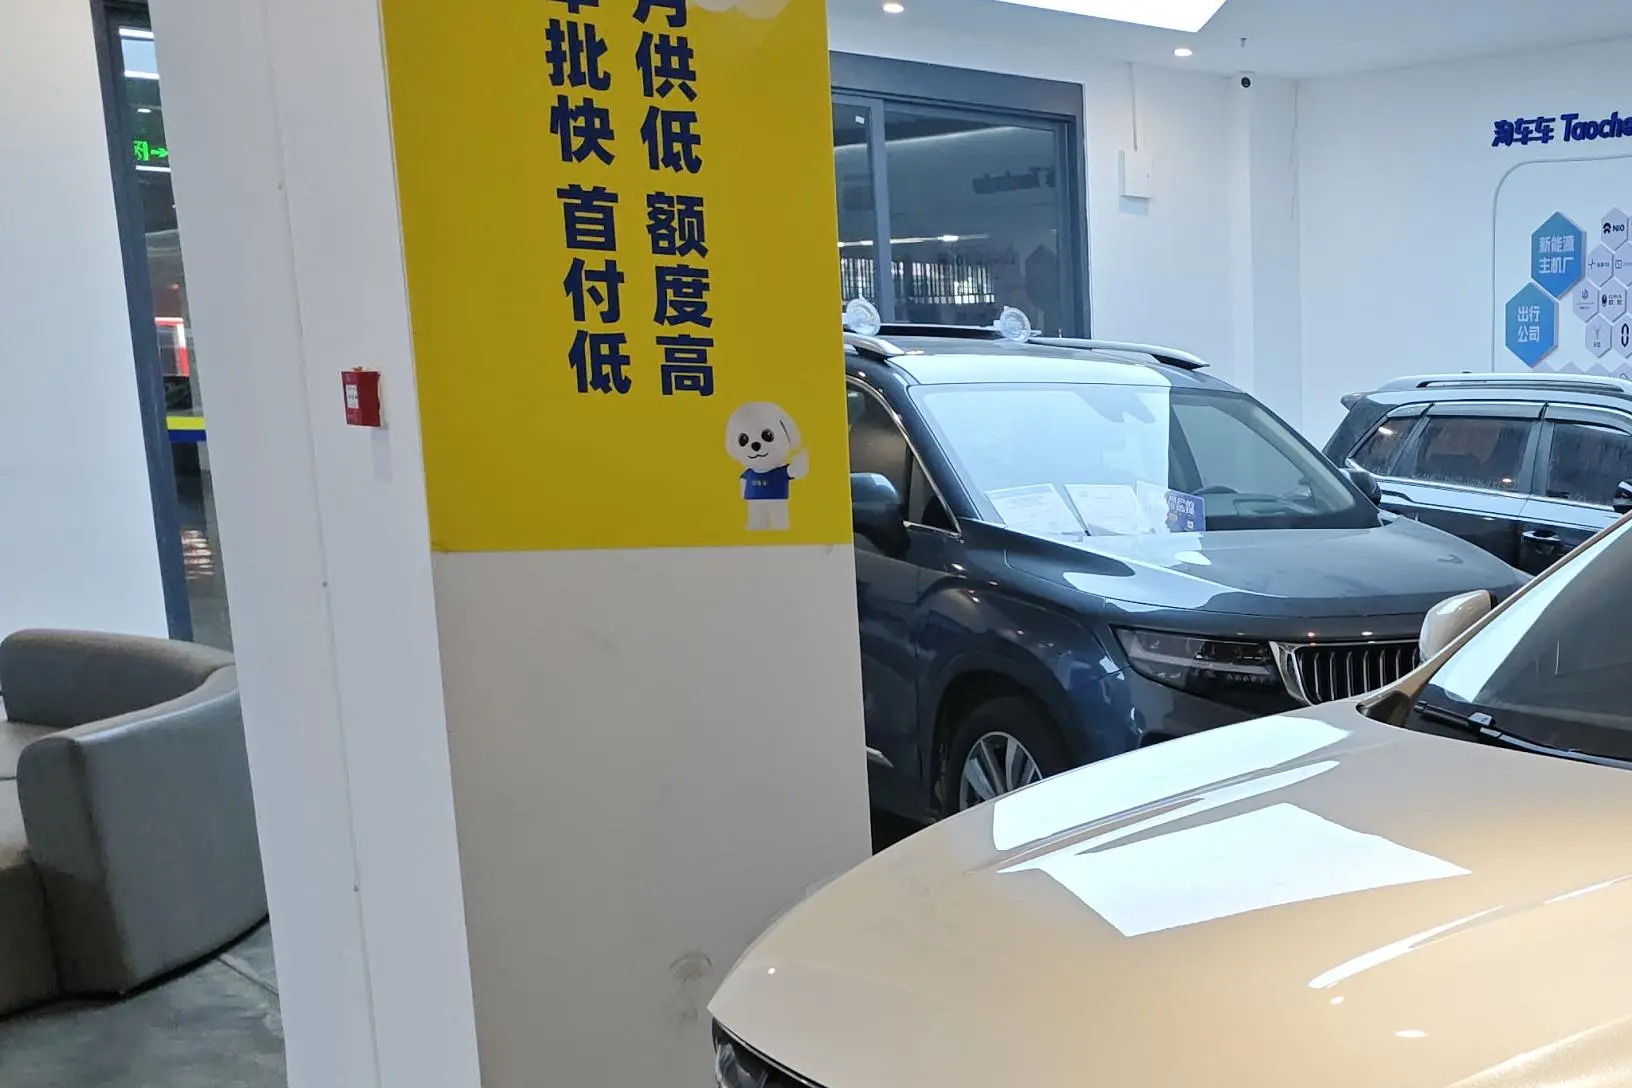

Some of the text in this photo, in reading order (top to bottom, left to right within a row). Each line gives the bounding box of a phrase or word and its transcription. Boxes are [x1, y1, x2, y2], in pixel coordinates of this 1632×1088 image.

[1491, 115, 1557, 147] 淘车车
[1539, 234, 1575, 253] 新能源
[1538, 256, 1575, 275] 主机厂
[556, 183, 632, 395] 首付低
[646, 191, 715, 397] 额度高
[1517, 305, 1541, 323] 出行
[1517, 325, 1540, 343] 公司
